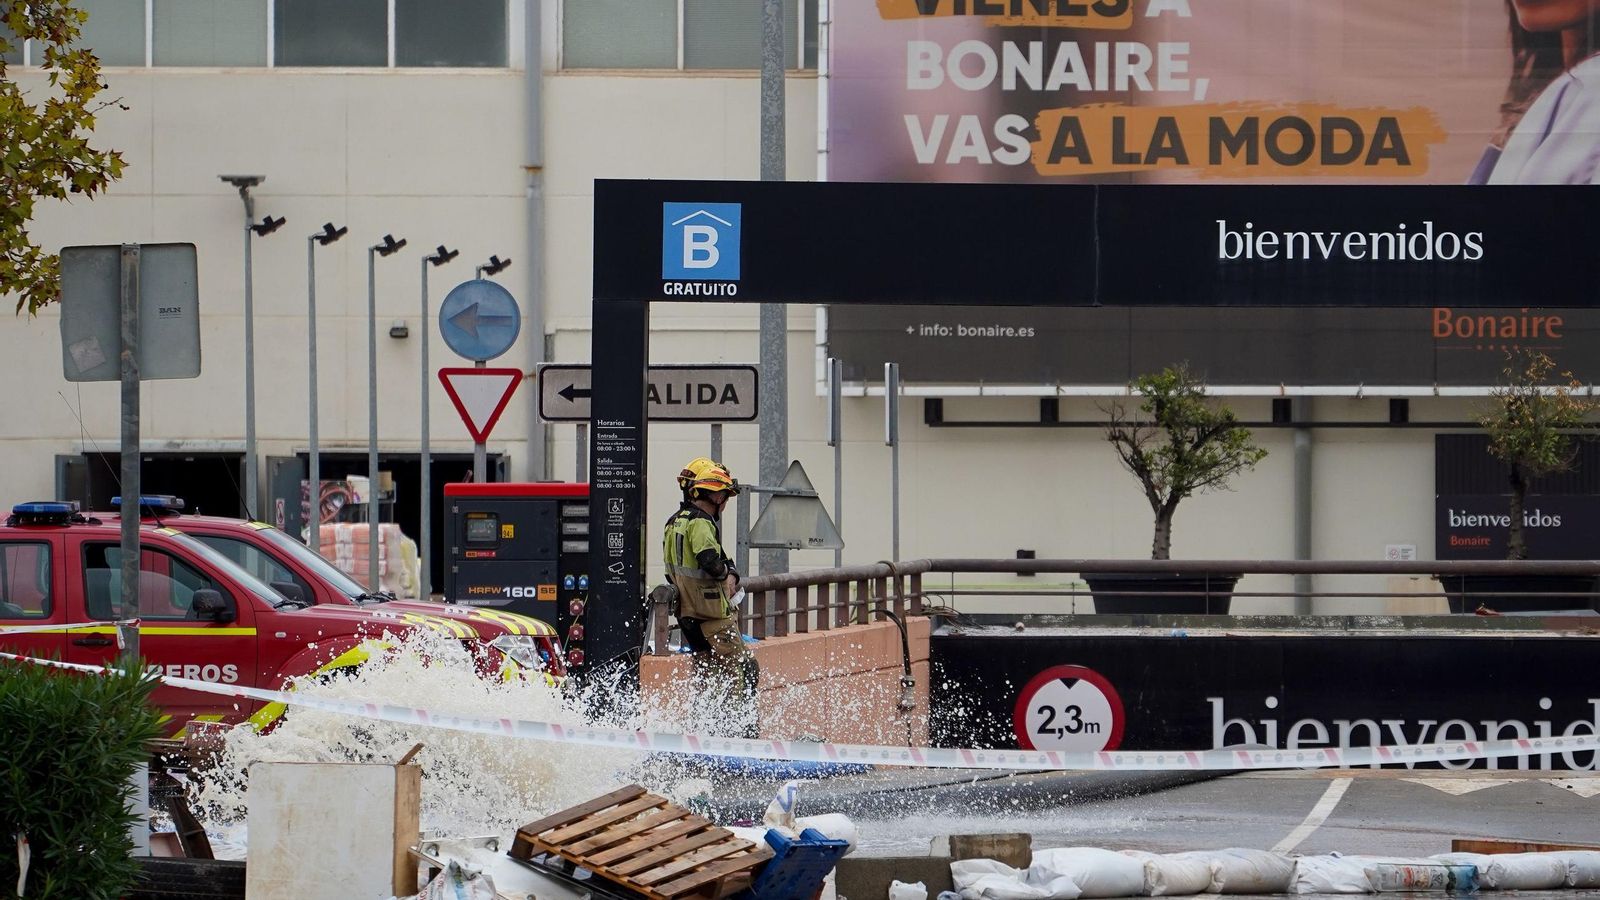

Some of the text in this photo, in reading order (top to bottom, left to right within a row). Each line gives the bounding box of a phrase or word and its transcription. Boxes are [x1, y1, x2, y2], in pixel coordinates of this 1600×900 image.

[906, 40, 1209, 100] BONAIRE,
[904, 114, 1412, 166] VAS A LA MODA
[683, 225, 720, 269] B
[1216, 220, 1484, 260] bienvenidos
[663, 282, 738, 296] GRATUITO
[920, 324, 953, 336] info:
[957, 323, 1035, 337] bonaire.es
[1432, 307, 1563, 338] Bonaire
[647, 383, 740, 405] ALIDA
[1449, 509, 1561, 527] bienveidos
[1451, 535, 1491, 546] Bonaire
[502, 586, 536, 598] 160
